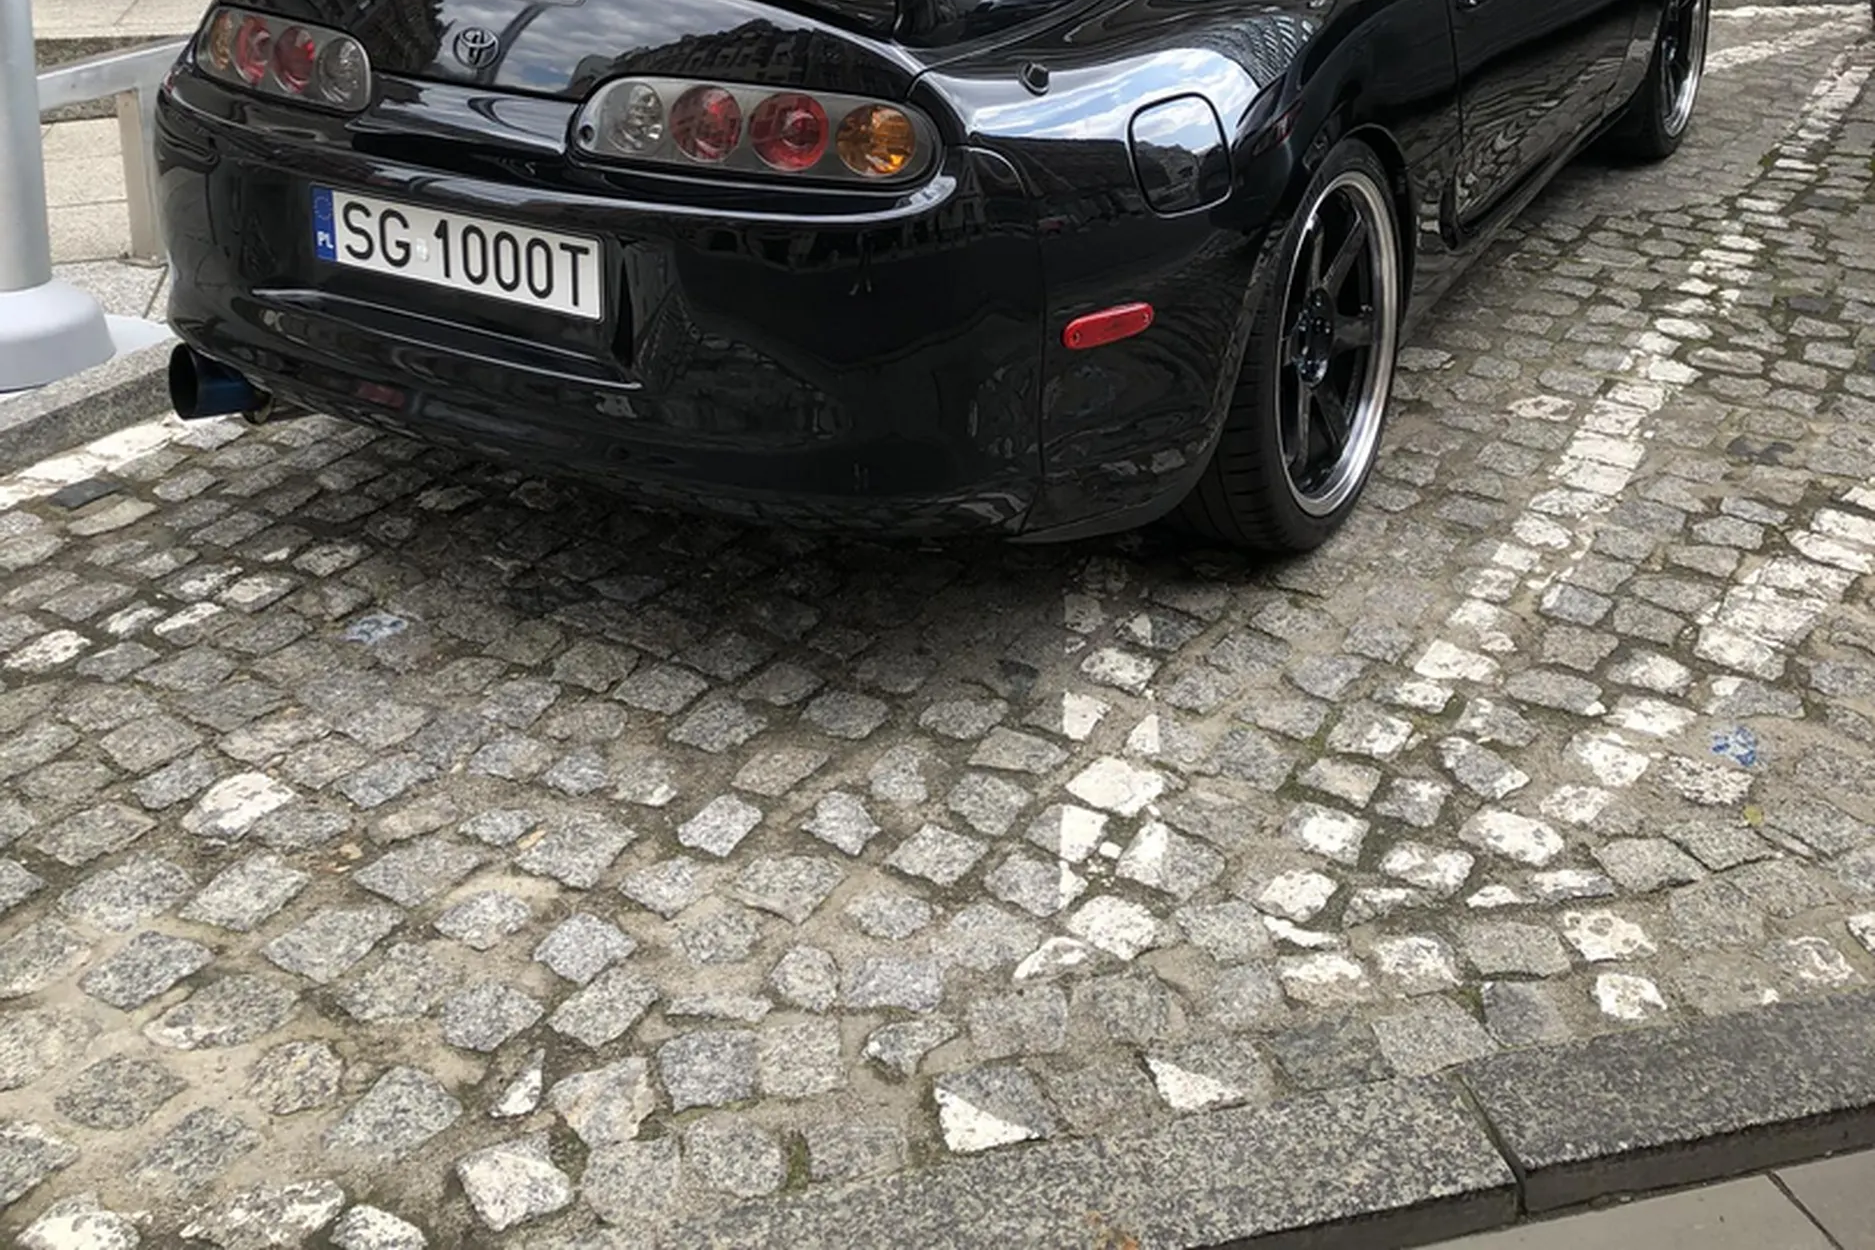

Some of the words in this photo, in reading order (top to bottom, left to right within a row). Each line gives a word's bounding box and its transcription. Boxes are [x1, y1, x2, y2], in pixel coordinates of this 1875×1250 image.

[317, 231, 334, 249] PL
[342, 201, 412, 268] SG
[433, 219, 591, 307] 1000T
